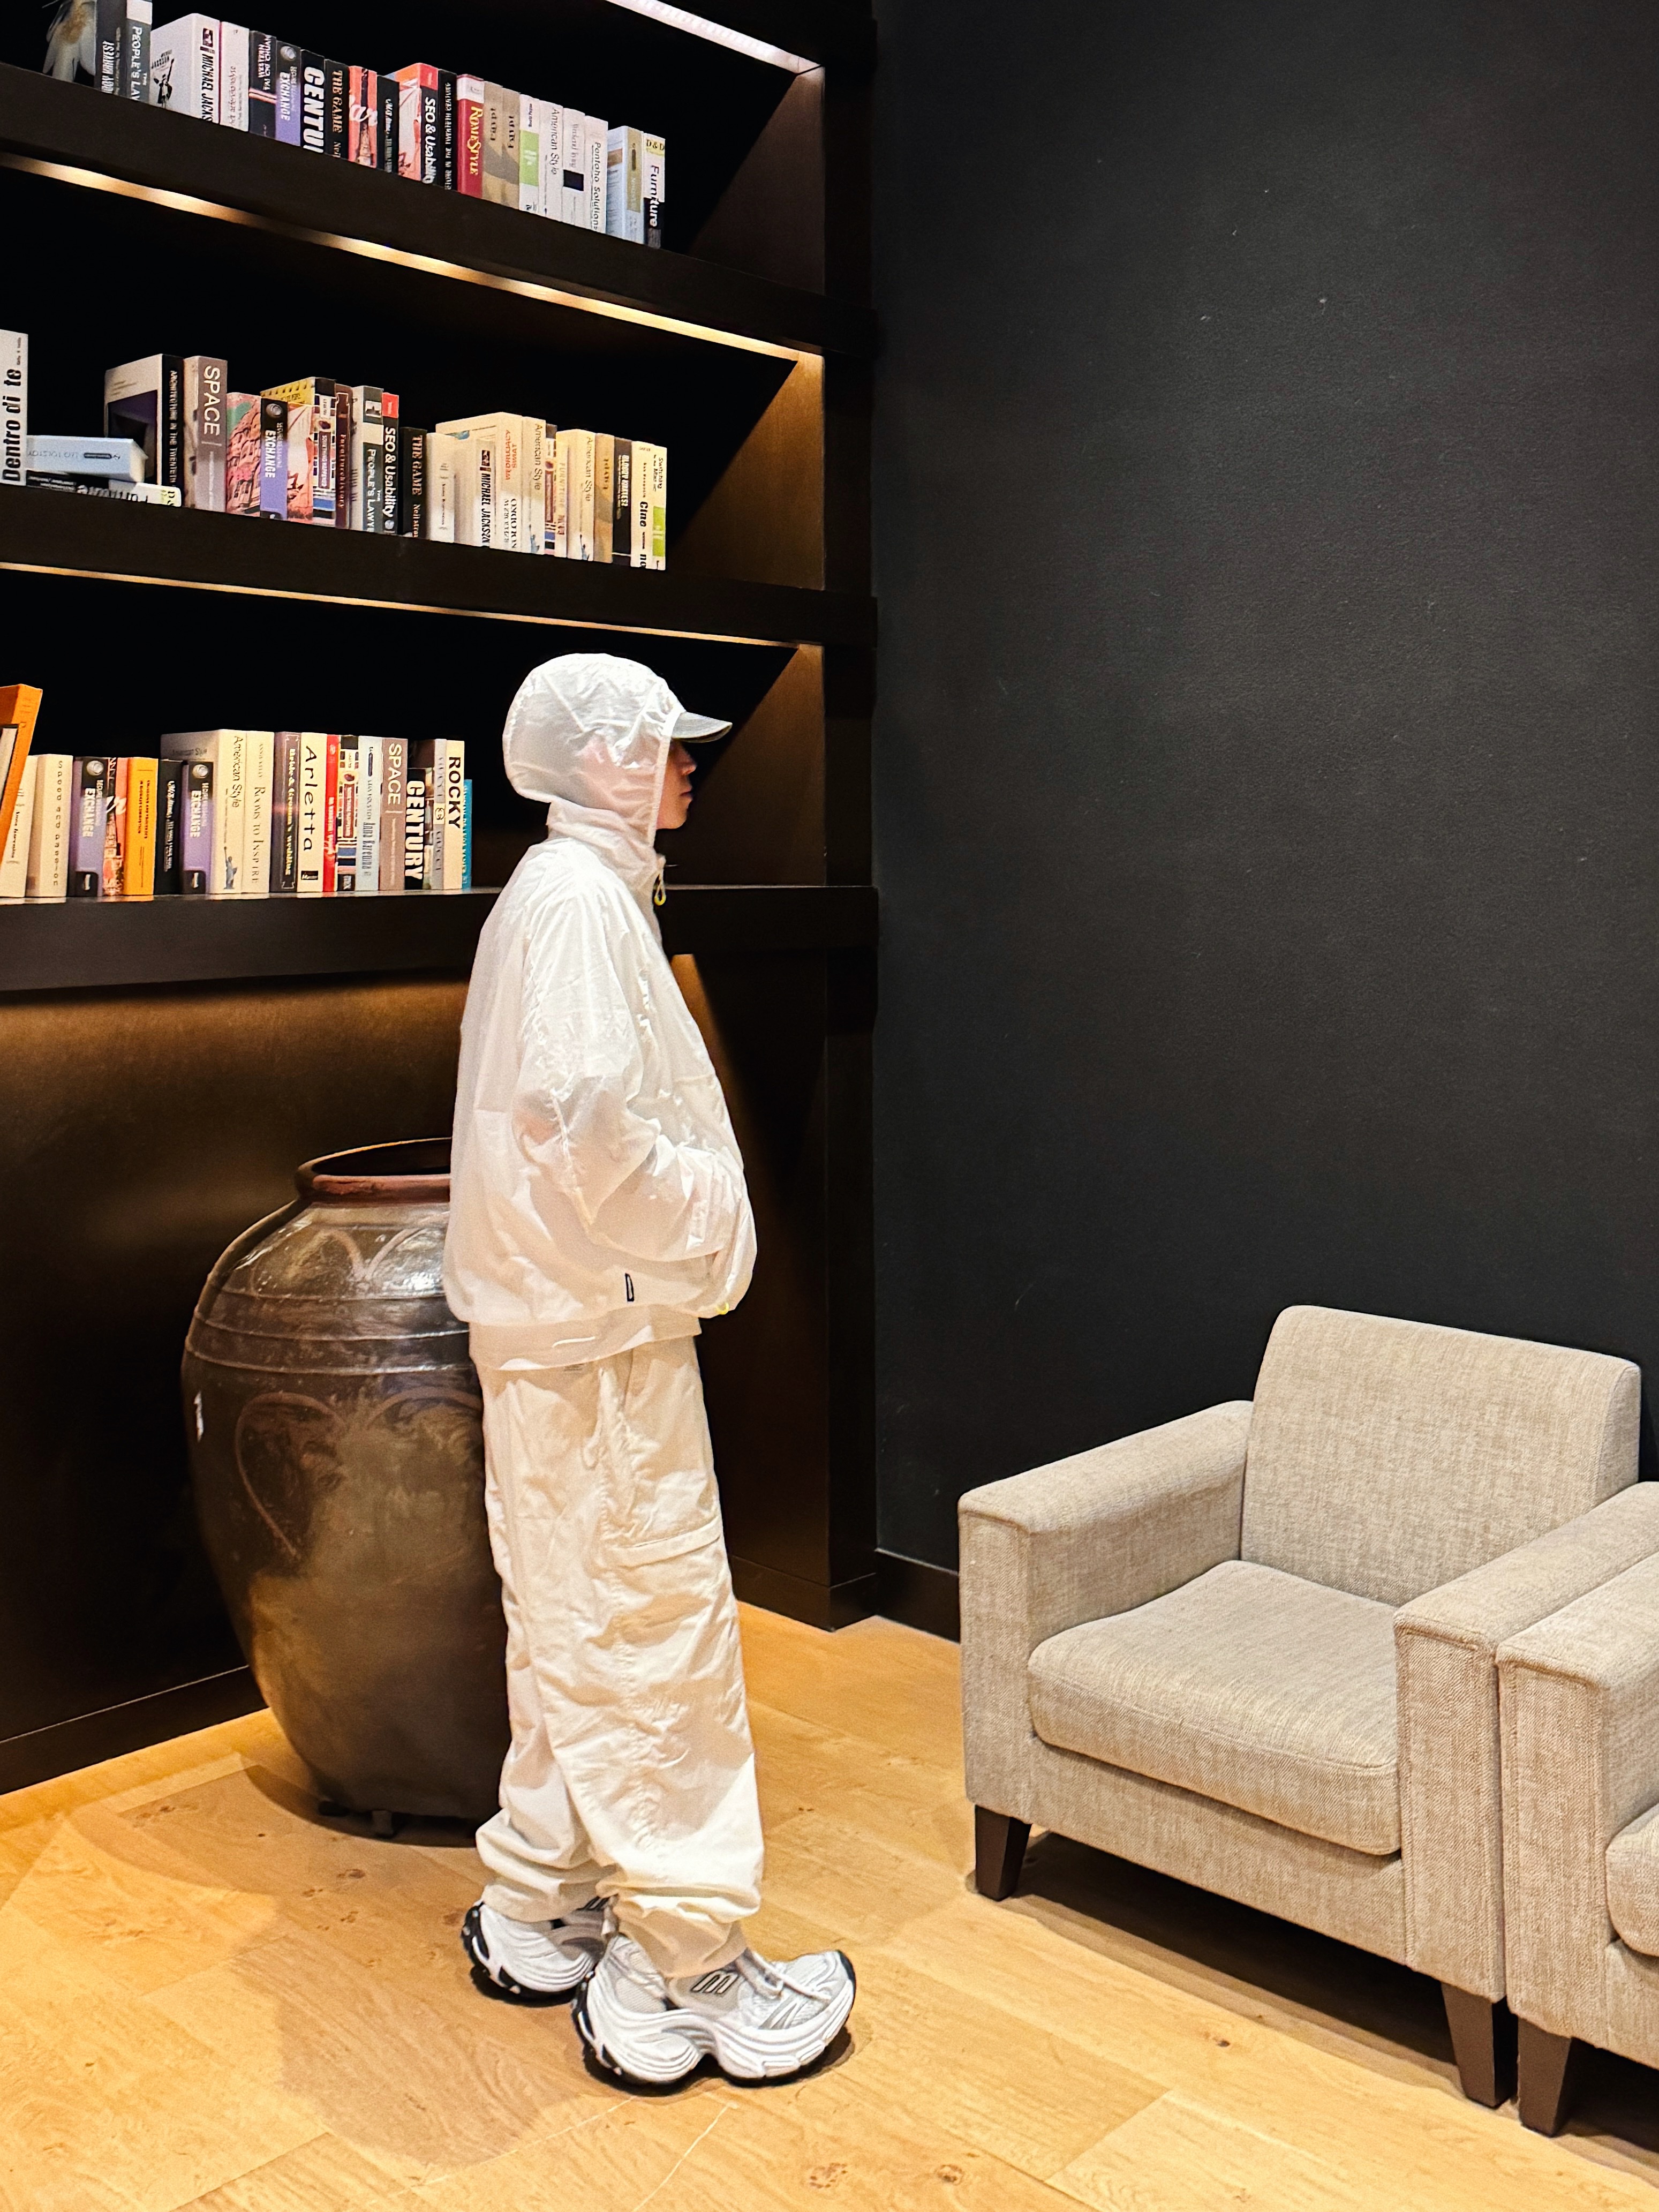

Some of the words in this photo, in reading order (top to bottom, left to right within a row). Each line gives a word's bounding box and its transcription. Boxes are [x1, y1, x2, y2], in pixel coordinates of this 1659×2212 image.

[130, 26, 142, 79] PEOPLE'S
[202, 54, 214, 91] MICHAEL
[331, 70, 343, 95] THE
[279, 72, 290, 121] EXCHANGE
[331, 96, 343, 133] GAME
[425, 97, 436, 123] SEO
[425, 124, 436, 134] &
[650, 165, 660, 227] Furniture
[3, 368, 21, 386] te
[2, 395, 21, 414] di
[203, 365, 220, 436] SPACE
[2, 420, 21, 482] Dentro
[265, 430, 276, 478] EXCHANGE
[385, 427, 396, 453] SEO
[385, 453, 396, 463] &
[412, 434, 423, 459] THE
[534, 424, 543, 465] American
[366, 449, 376, 496] PEOPLE'S
[382, 465, 397, 517] Usability
[412, 461, 423, 495] GAME
[481, 473, 491, 506] MICHAEL
[532, 468, 543, 491] Style
[233, 735, 243, 781] American
[388, 743, 403, 805] SPACE
[230, 784, 243, 808] Style
[304, 746, 318, 852] Arletta
[448, 757, 461, 829] ROCKY
[82, 788, 95, 838] EXCHANGE
[190, 790, 201, 838] EXCHANGE
[363, 822, 375, 838] Anna
[404, 780, 425, 880] CENTURY
[362, 840, 375, 869] Karenina
